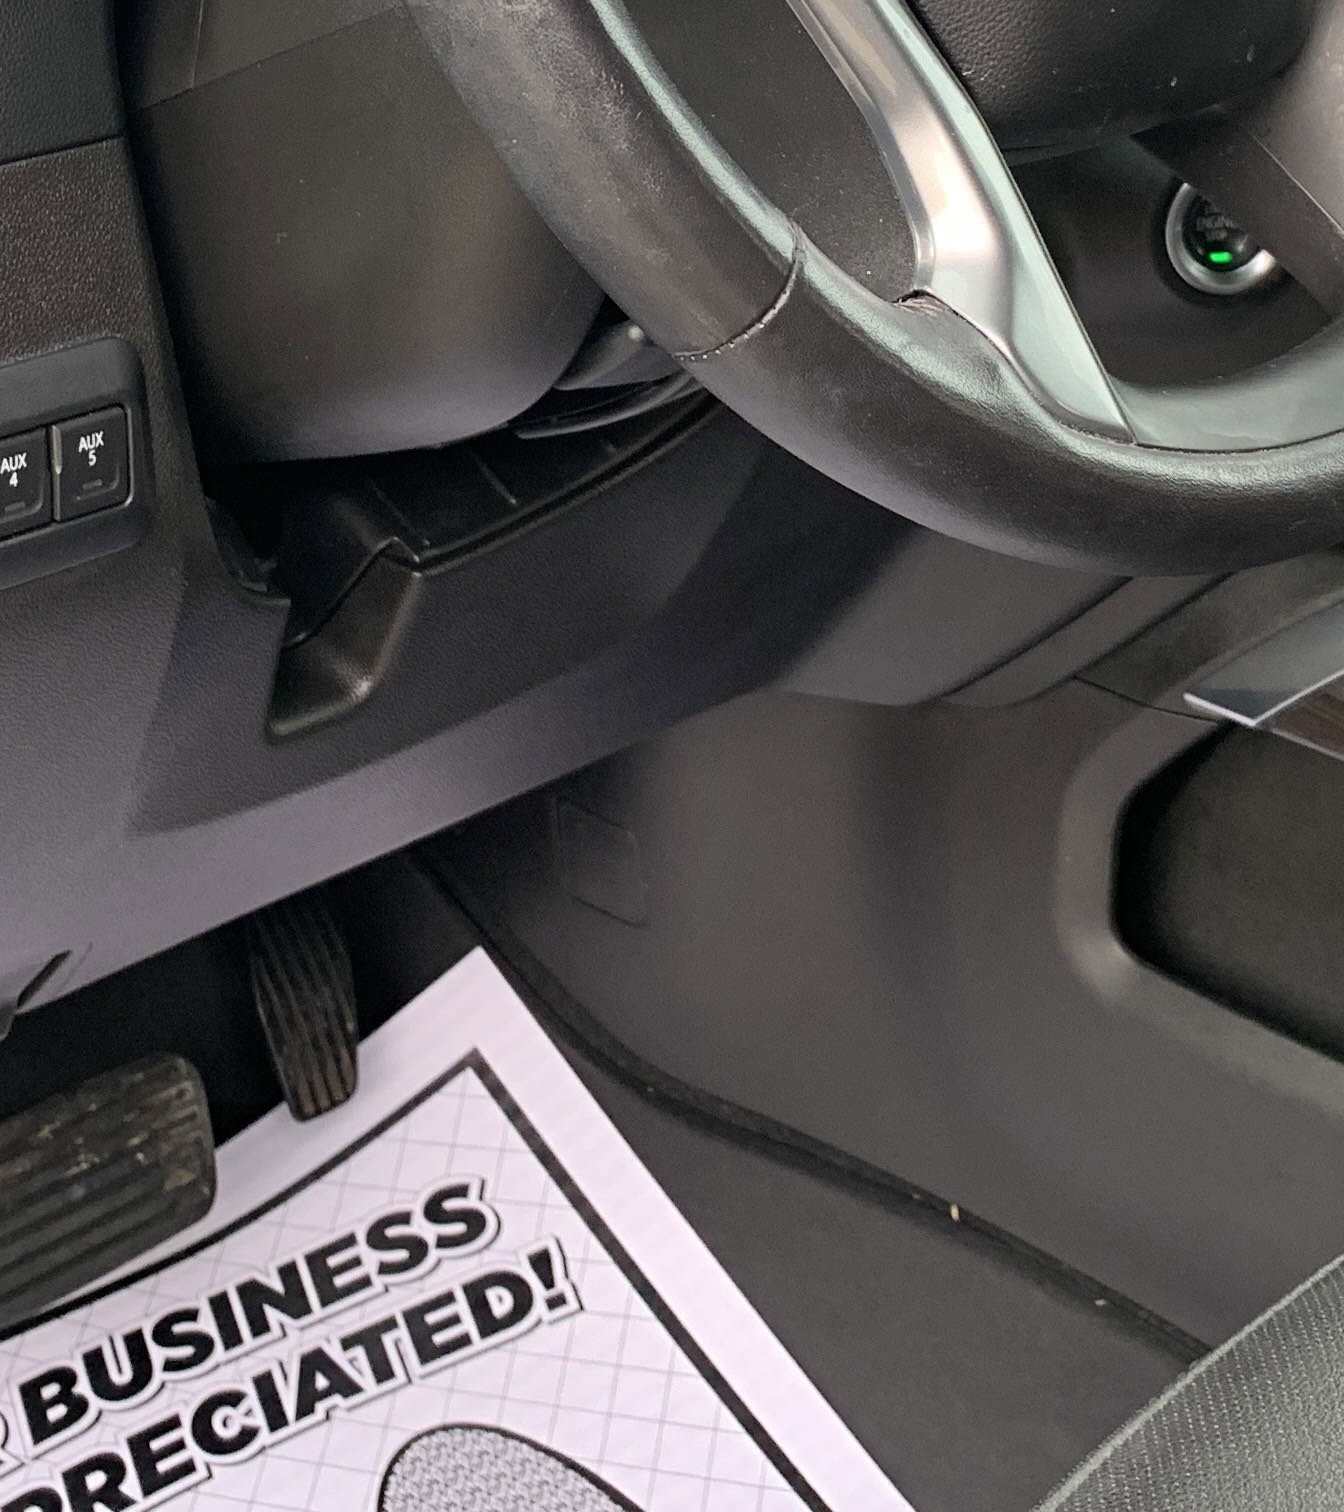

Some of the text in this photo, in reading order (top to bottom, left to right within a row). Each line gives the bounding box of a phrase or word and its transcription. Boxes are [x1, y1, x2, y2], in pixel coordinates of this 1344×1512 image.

[78, 431, 104, 453] AUX
[0, 453, 27, 475] AUX
[88, 450, 97, 466] 5
[9, 472, 18, 487] 4
[19, 1183, 487, 1446] BUSINESS
